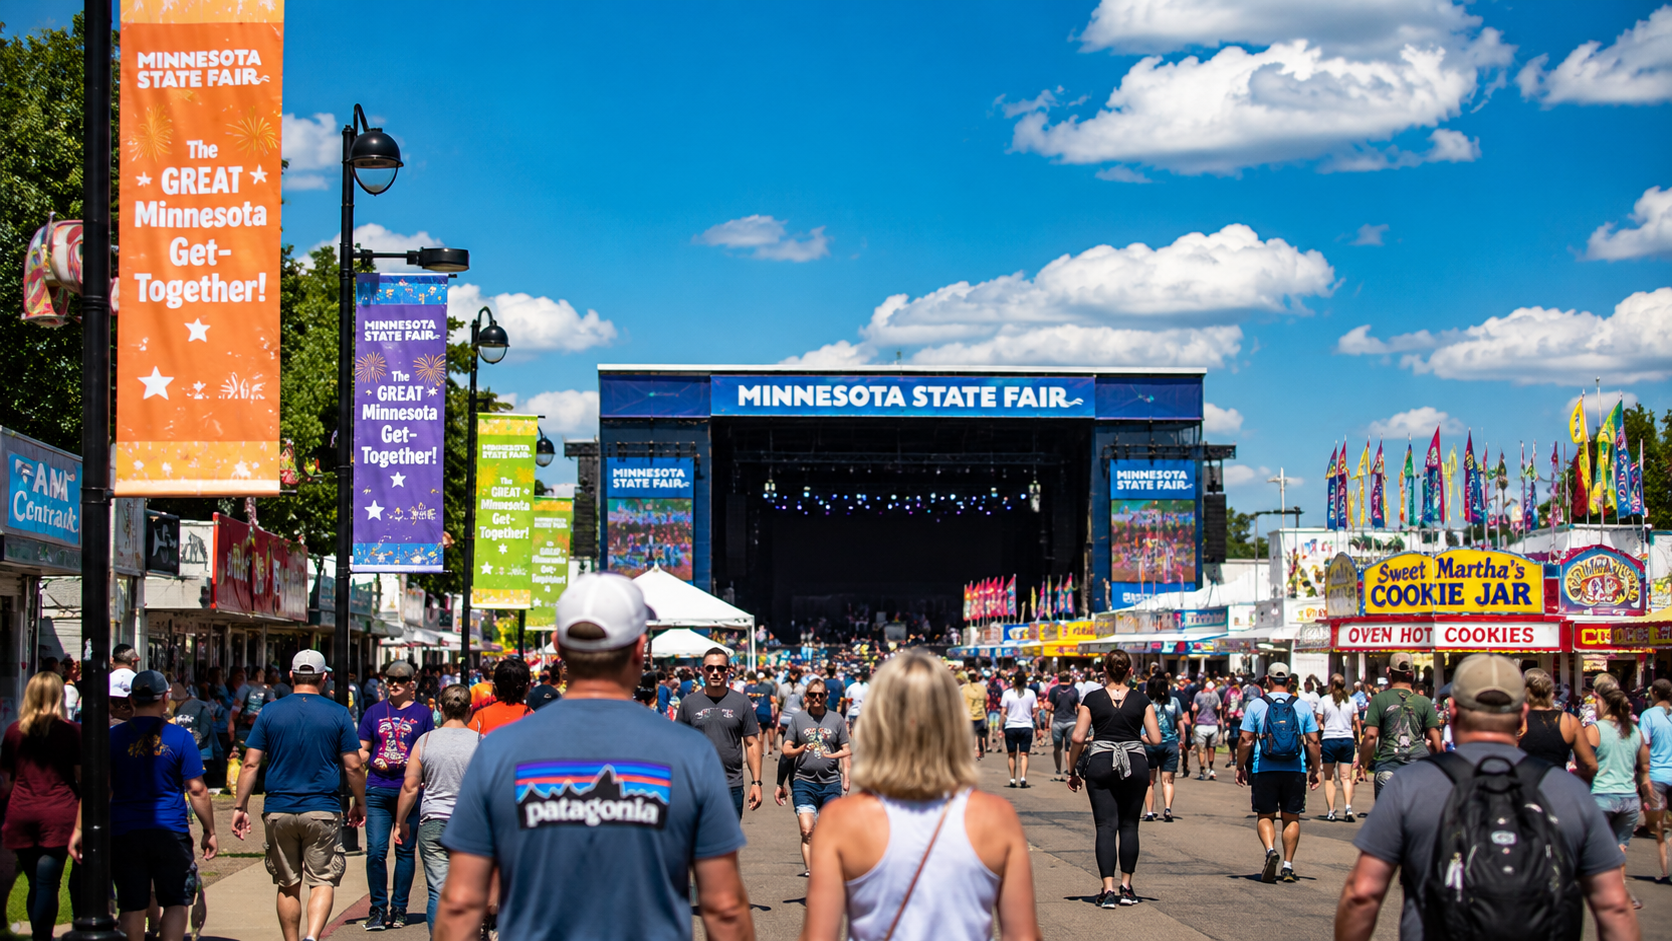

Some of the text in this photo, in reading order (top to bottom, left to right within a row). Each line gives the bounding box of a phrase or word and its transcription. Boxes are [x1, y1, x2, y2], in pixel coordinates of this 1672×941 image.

[137, 49, 262, 68] MINNESOTA
[137, 68, 270, 88] STATE FAIR
[186, 139, 218, 159] The
[161, 166, 243, 195] GREAT
[134, 200, 267, 228] Minnesota
[169, 236, 232, 267] Get-
[133, 272, 267, 310] Together!
[364, 320, 436, 331] MINNESOTA
[364, 330, 440, 342] STATE FAIR
[391, 371, 410, 382] The
[377, 385, 424, 401] GREAT
[737, 384, 1084, 408] MINNESOTA STATE FAIR
[362, 404, 438, 421] Minnesota
[381, 425, 418, 444] Get-
[361, 446, 437, 468] Together!
[500, 477, 513, 485] The
[612, 468, 686, 479] MINNESOTA
[1116, 470, 1188, 480] MINNESOTA
[491, 486, 521, 498] GREAT
[612, 478, 690, 489] STATE FAIR
[1116, 480, 1194, 490] STATE FAIR
[480, 499, 530, 511] Minnesota
[492, 512, 516, 525] Get-
[479, 526, 530, 541] Together!
[1377, 560, 1426, 584] Sweet
[1434, 556, 1525, 580] Martha's
[1370, 582, 1465, 608] COOKIE
[1474, 582, 1532, 606] JAR
[1348, 626, 1393, 644] OVEN
[1400, 626, 1433, 643] HOT
[1444, 627, 1534, 643] COOKIES
[525, 797, 660, 828] patagonia
